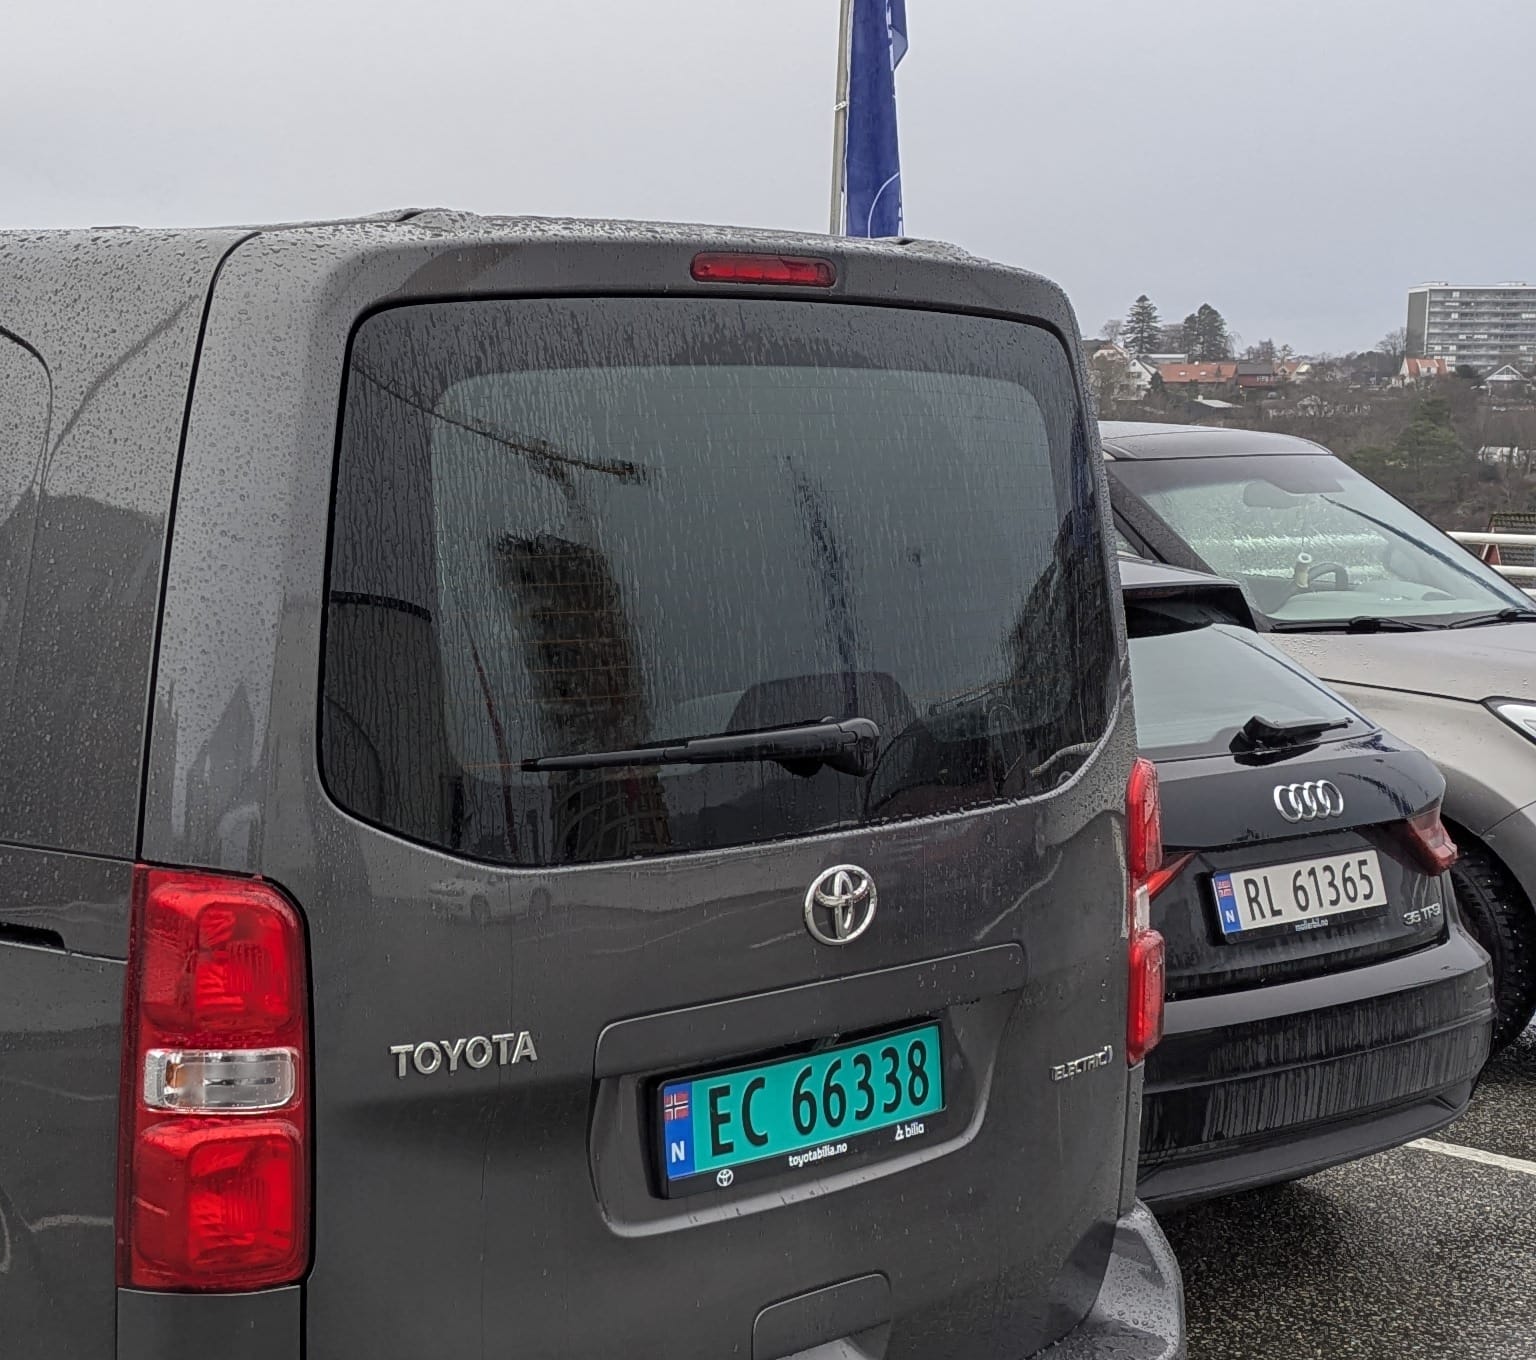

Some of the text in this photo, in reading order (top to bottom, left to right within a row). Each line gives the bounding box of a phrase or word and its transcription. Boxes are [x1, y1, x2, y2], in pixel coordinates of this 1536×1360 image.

[1243, 858, 1374, 921] RL 61365
[1225, 909, 1235, 924] N
[390, 1030, 538, 1078] TOYOTA
[708, 1038, 930, 1158] EC 66338
[904, 1121, 925, 1138] bilia
[670, 1140, 685, 1163] N
[788, 1142, 848, 1168] toyotabilia.no
